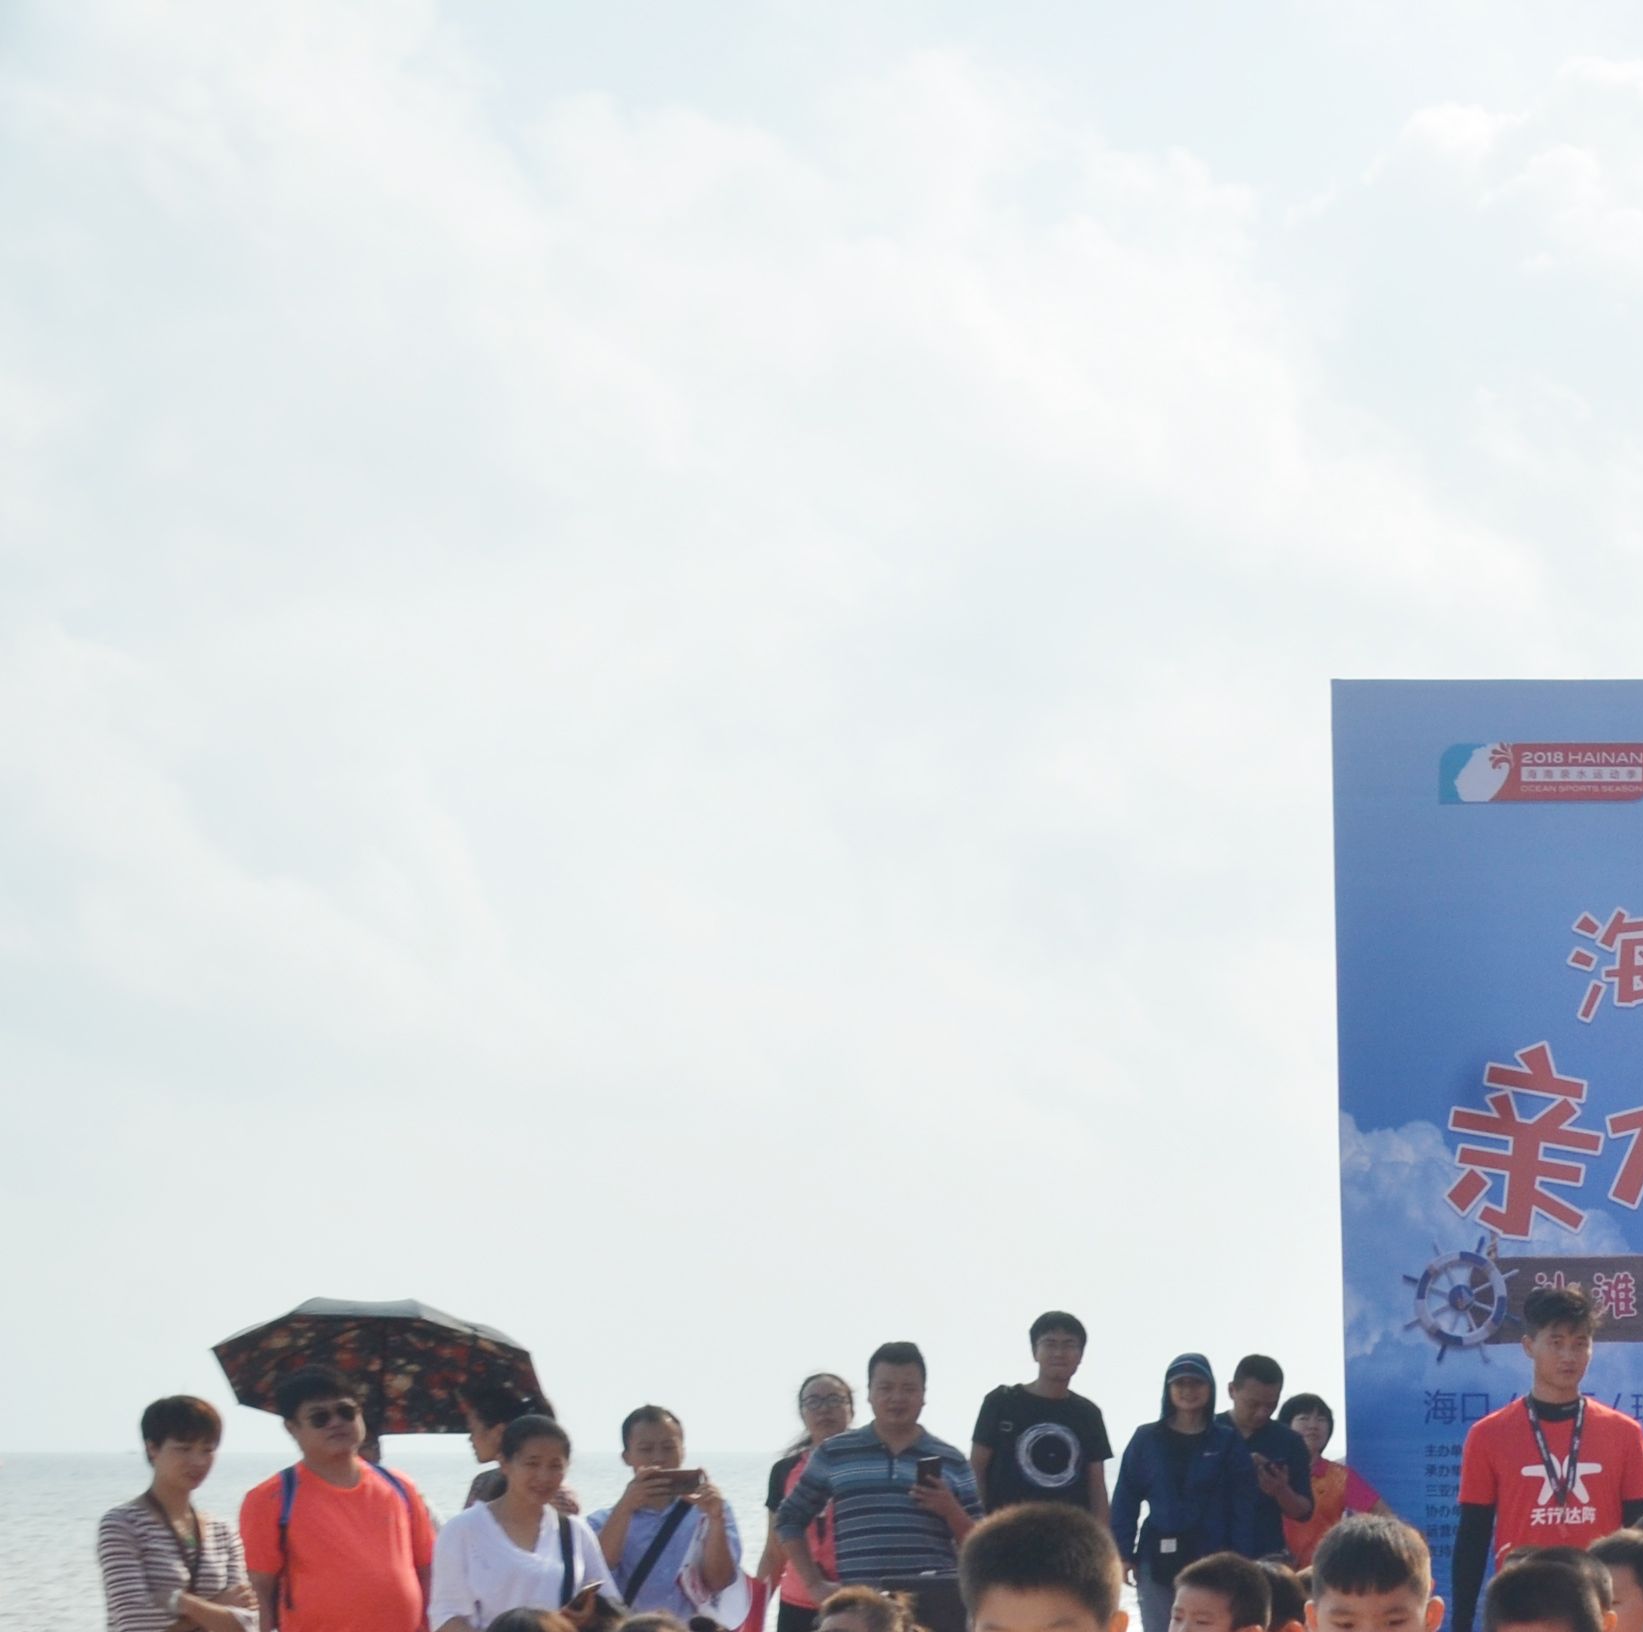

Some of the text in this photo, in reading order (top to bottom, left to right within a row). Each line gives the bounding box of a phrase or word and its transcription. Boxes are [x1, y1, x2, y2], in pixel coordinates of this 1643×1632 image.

[1521, 752, 1643, 764] 2018 HAINAN
[1521, 784, 1643, 793] OCEAN SPORTS SEASON
[1424, 1390, 1491, 1425] 海口
[1530, 1506, 1597, 1526] 天行达阵
